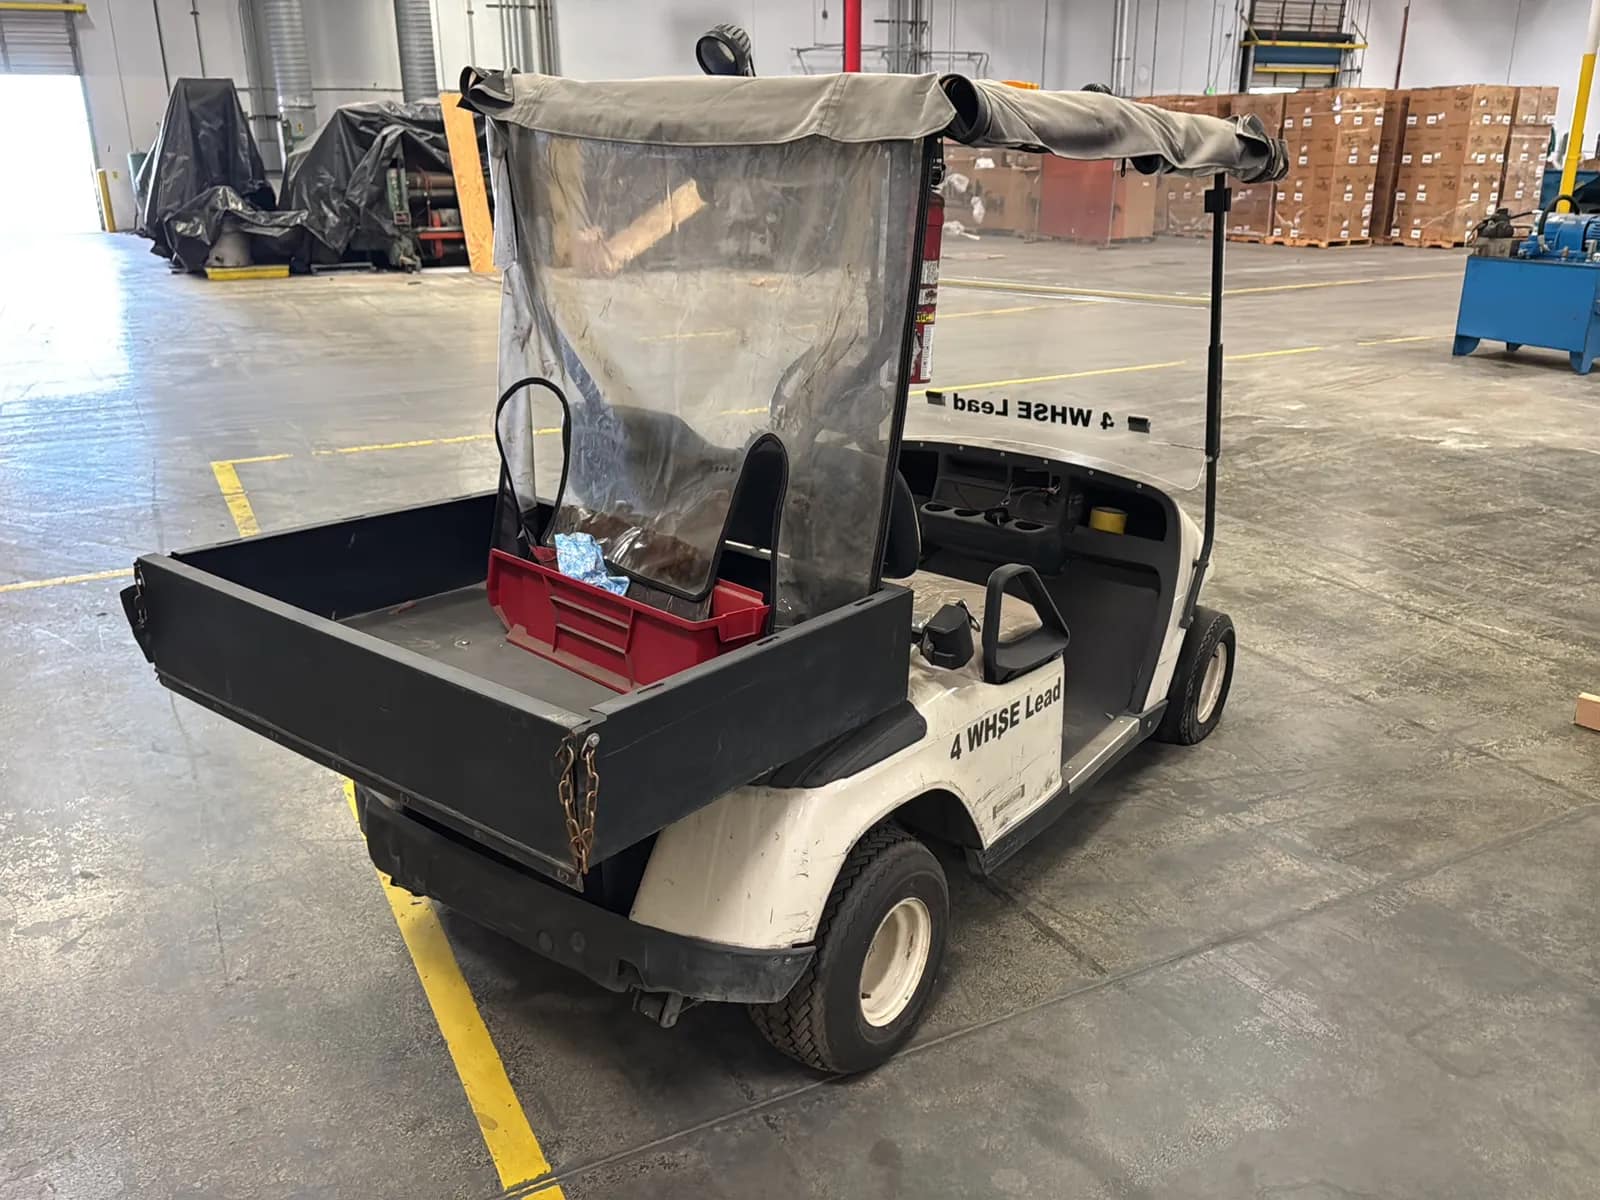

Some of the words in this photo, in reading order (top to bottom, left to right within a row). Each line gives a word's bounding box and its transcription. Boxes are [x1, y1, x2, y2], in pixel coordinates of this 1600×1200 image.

[950, 732, 962, 761] 4
[967, 700, 1021, 753] WHSE
[1025, 677, 1062, 720] Lead
